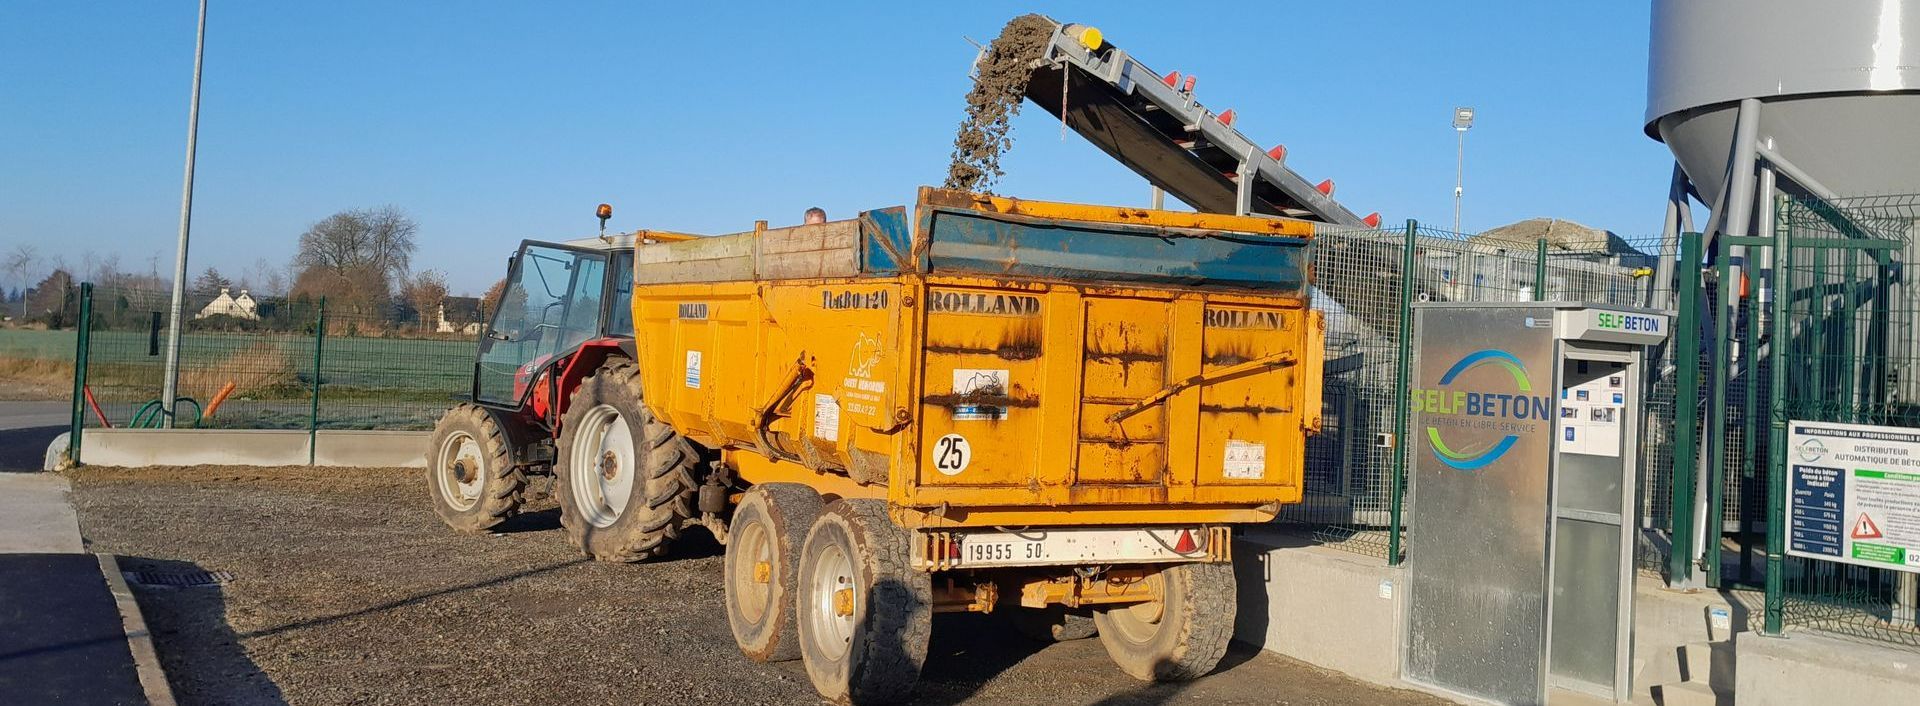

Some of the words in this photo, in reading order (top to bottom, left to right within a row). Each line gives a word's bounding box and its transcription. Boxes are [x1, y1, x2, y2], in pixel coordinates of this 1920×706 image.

[928, 291, 1040, 316] ROLLAND
[678, 303, 708, 319] ROLLAND
[1598, 312, 1660, 333] SELFBETON
[1410, 389, 1550, 421] SELFBETON
[1460, 420, 1471, 428] EN
[1473, 420, 1497, 430] LIBRE
[1500, 422, 1536, 433] SERVICE
[1804, 428, 1847, 437] INFORMATIONS
[1862, 432, 1914, 442] PROFESSIONNELS
[938, 437, 964, 470] 25
[1795, 446, 1829, 454] SELFBETON
[1854, 446, 1909, 456] DISTRIBUTEUR
[1834, 453, 1889, 465] AUTOMATIQUE
[1890, 457, 1900, 466] DE
[1799, 466, 1814, 475] Poids
[1822, 468, 1838, 477] béton
[969, 543, 1012, 561] 19955
[1026, 543, 1042, 559] 50
[1909, 554, 1920, 563] 02
